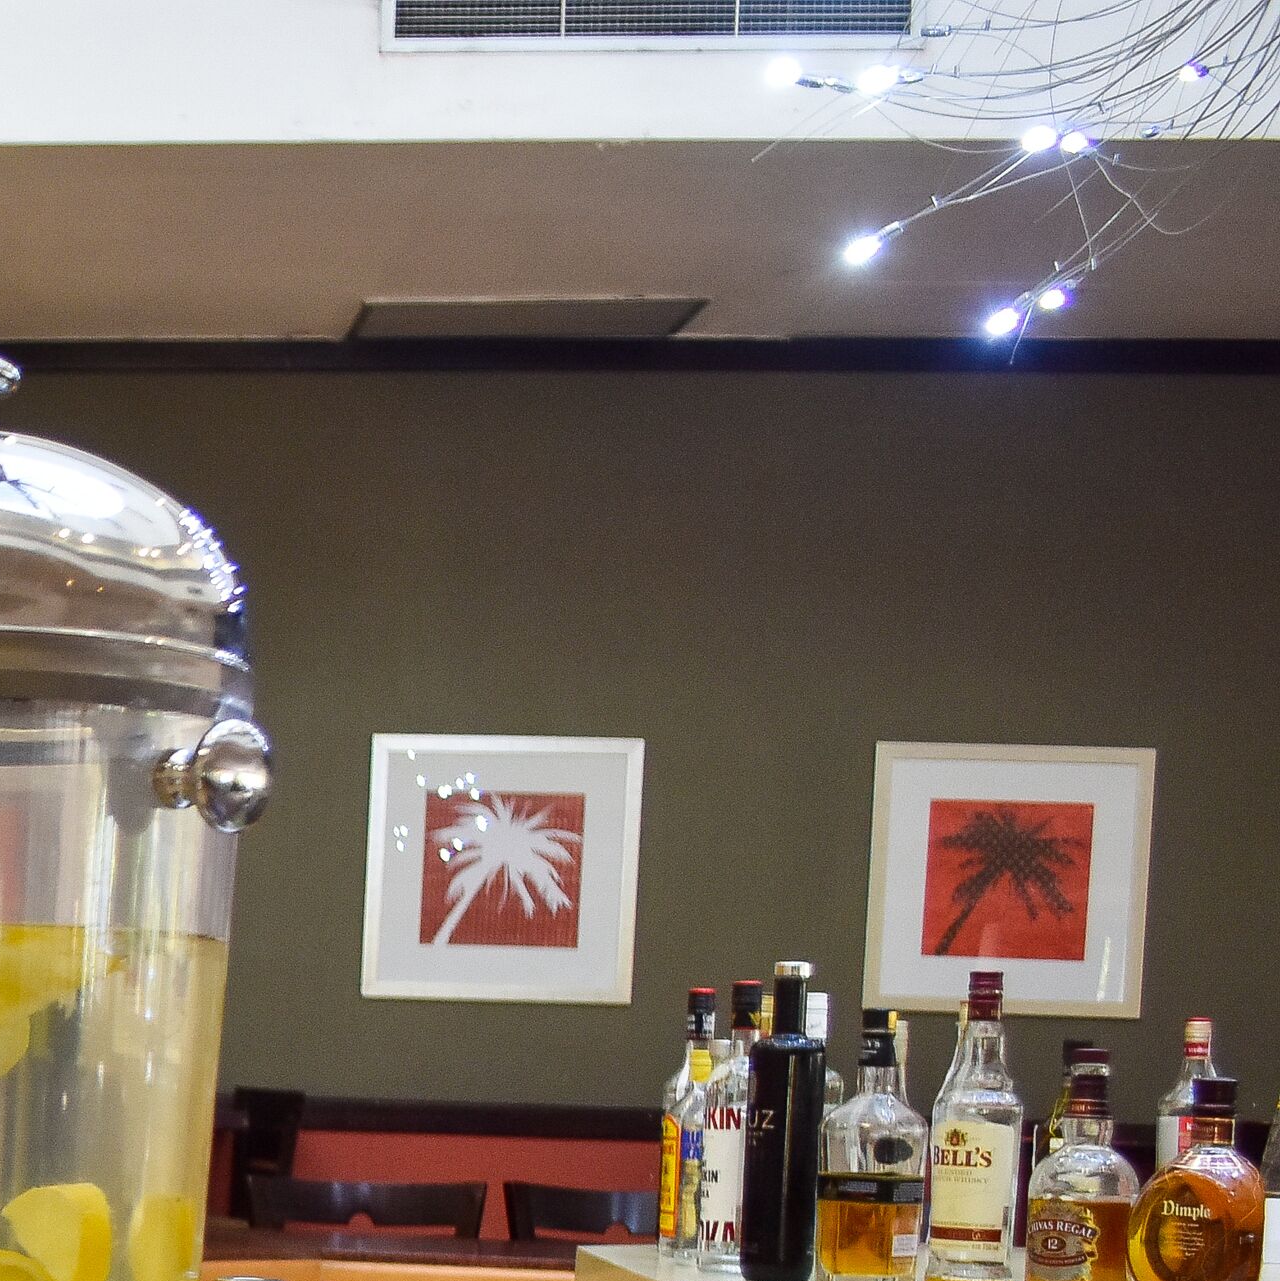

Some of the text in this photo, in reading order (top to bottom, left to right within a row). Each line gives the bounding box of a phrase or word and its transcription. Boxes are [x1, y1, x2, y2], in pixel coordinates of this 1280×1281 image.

[933, 1145, 993, 1168] BELL'S
[1161, 1200, 1212, 1221] Dimple
[1028, 1220, 1094, 1239] CHIVAS REGAL
[1047, 1238, 1058, 1250] 12
